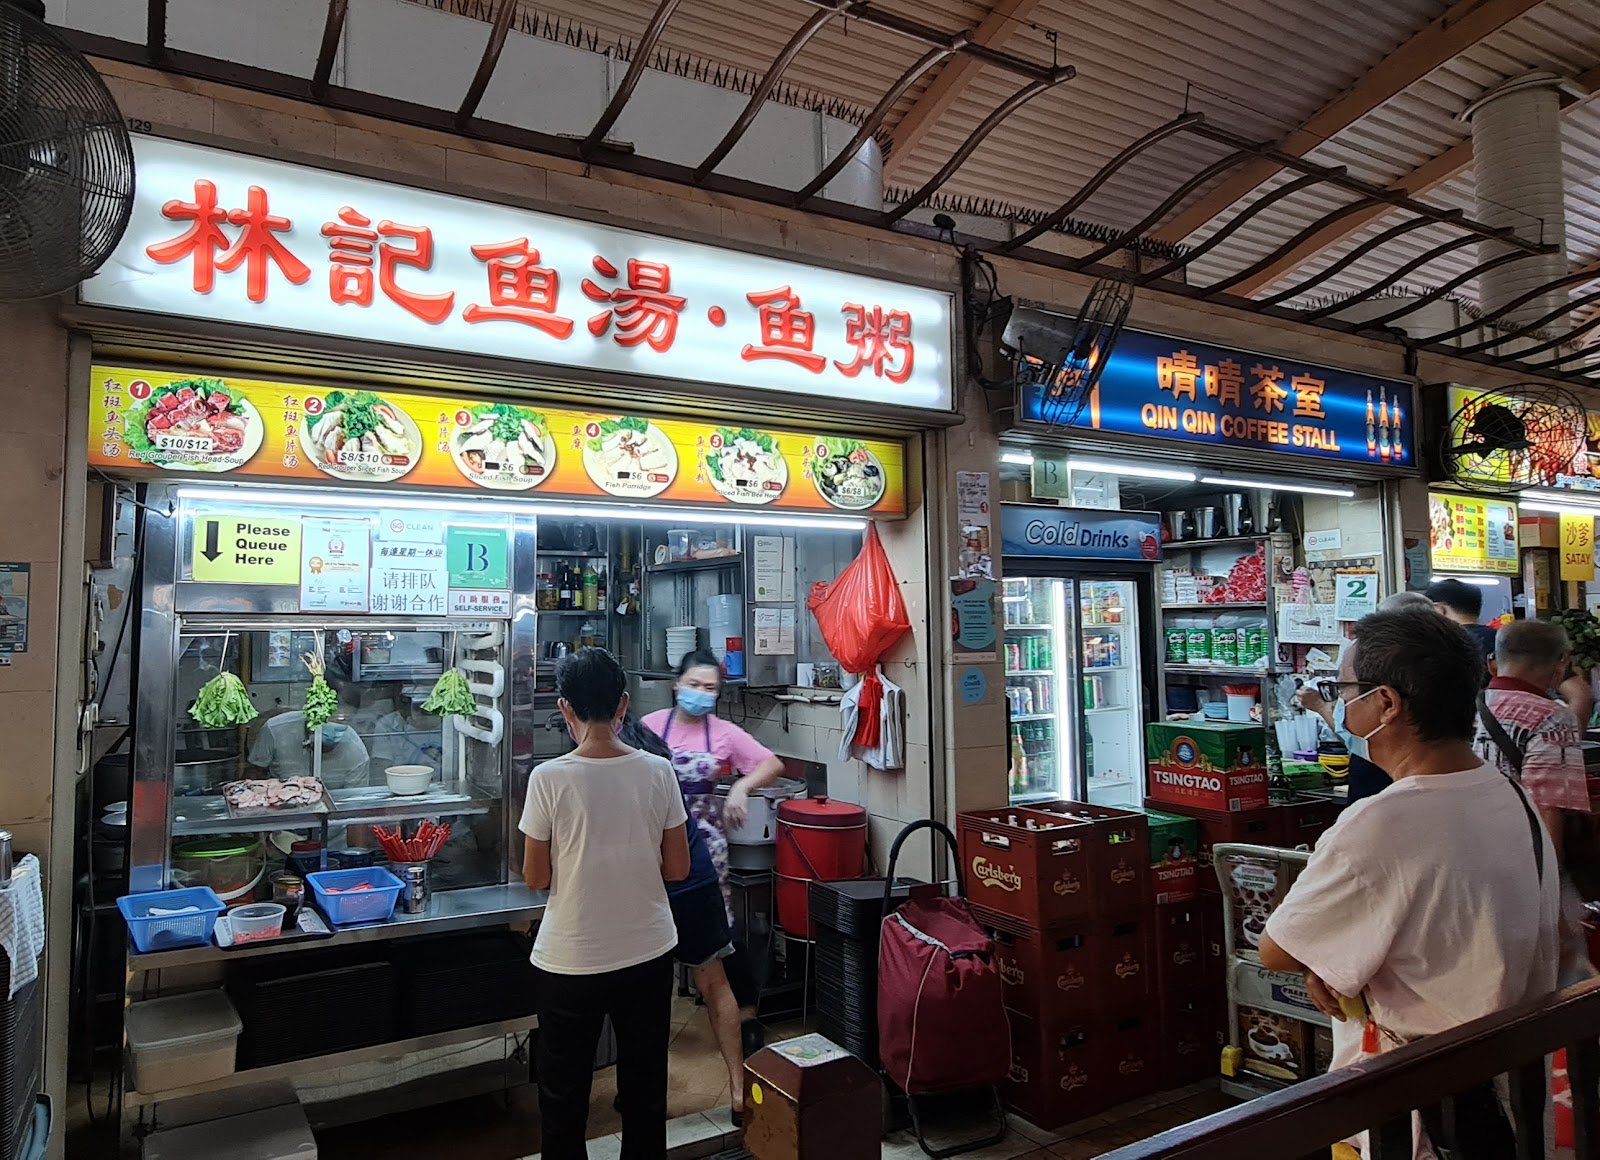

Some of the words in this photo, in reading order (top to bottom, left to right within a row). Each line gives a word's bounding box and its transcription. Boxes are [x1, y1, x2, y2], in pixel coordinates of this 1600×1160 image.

[128, 118, 152, 132] 129
[1156, 350, 1326, 419] 晴晴茶室
[103, 377, 123, 457] 红斑鱼头汤
[283, 395, 299, 467] 红斑鱼片汤
[1141, 403, 1177, 430] QIN
[1181, 408, 1216, 436] QIN
[1220, 414, 1289, 444] COFFEE
[1292, 423, 1341, 452] STALL
[160, 437, 208, 451] $10/$12
[128, 450, 145, 459] Red
[148, 451, 181, 462] Grouper
[183, 453, 200, 461] Fish
[340, 452, 379, 463] $8/$10
[318, 462, 332, 470] Red
[333, 464, 356, 473] Grouper
[357, 465, 376, 473] Sliced
[377, 466, 390, 474] Fish
[391, 467, 406, 475] Soup
[1043, 461, 1058, 485] B
[468, 472, 493, 481] Sliced
[495, 474, 513, 482] Fish
[514, 475, 533, 484] Soup
[605, 481, 620, 489] Fish
[622, 482, 652, 491] Porridge
[842, 487, 862, 496] $6/$8
[737, 490, 750, 498] Fish
[751, 491, 763, 499] Bee
[236, 522, 290, 538] Please
[406, 523, 434, 532] CLEAN
[1025, 519, 1080, 546] Cold
[1081, 529, 1129, 549] Drinks
[1565, 521, 1590, 547] 沙爹
[235, 538, 288, 553] Queue
[235, 553, 274, 566] Here
[466, 543, 489, 572] B
[1565, 553, 1590, 565] SATAY
[383, 571, 436, 590] 请排队
[1347, 580, 1368, 598] 2
[371, 592, 445, 612] 谢谢合作
[454, 604, 503, 612] SELF-SERVICE
[1153, 770, 1221, 792] TSINGTAO
[1229, 773, 1264, 787] TSINGTAO
[972, 856, 1021, 891] Carlsberg
[1157, 866, 1194, 881] TSINGTAO
